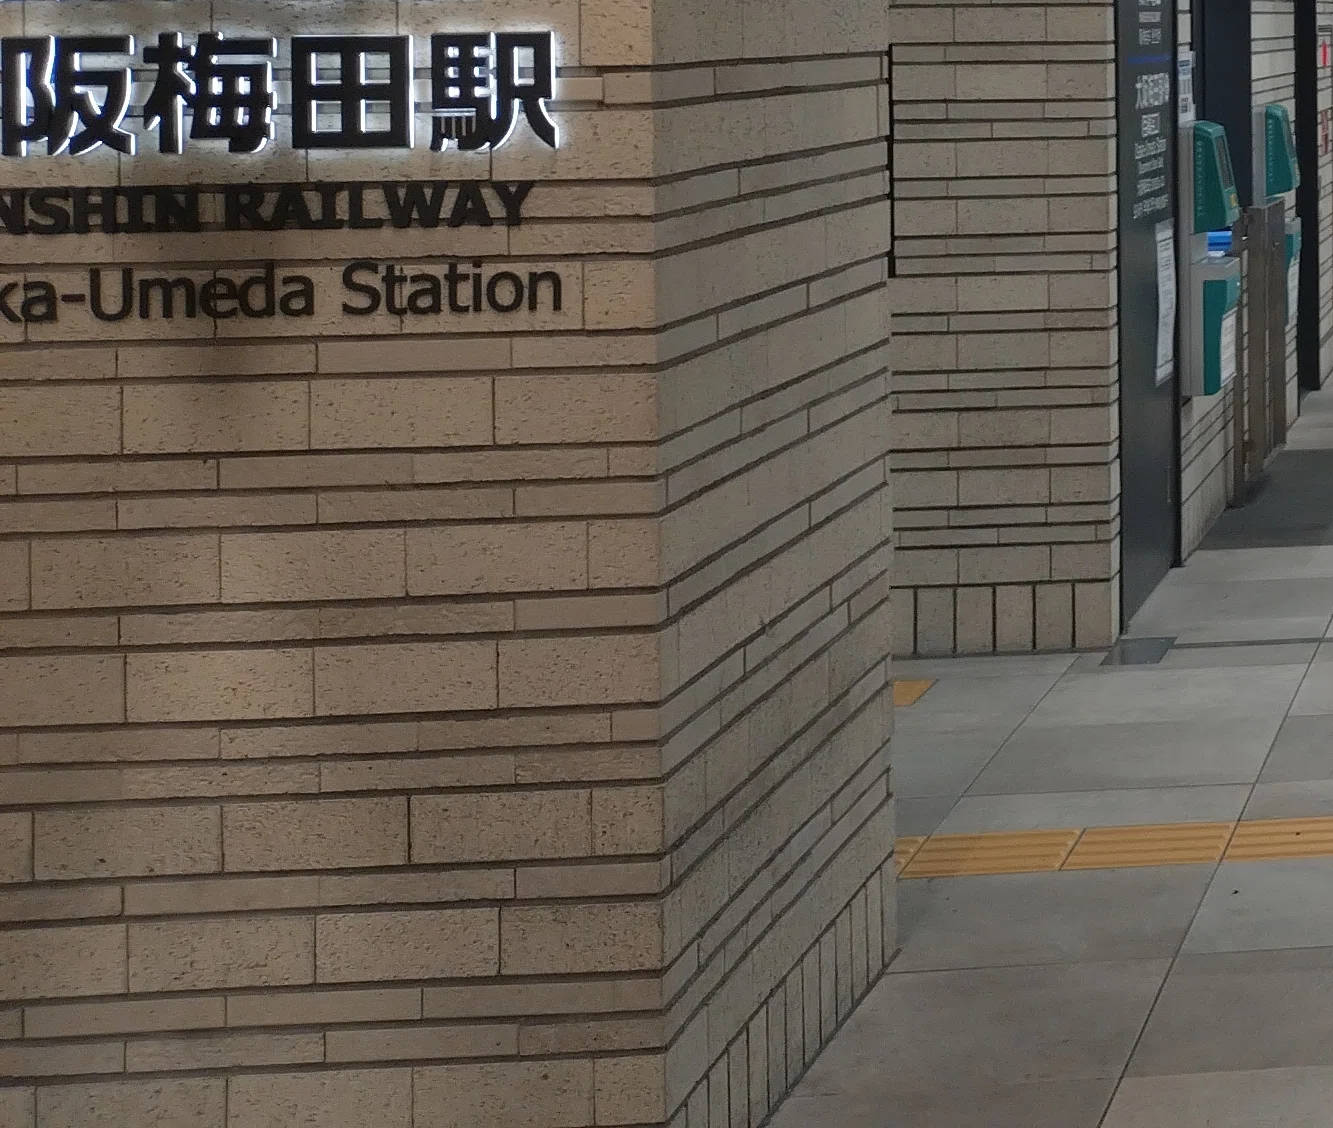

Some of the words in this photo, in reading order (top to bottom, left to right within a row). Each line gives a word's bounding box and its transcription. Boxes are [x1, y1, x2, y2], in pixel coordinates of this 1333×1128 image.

[2, 31, 560, 157] 阪梅田駅
[223, 181, 535, 231] RAILWAY
[341, 260, 562, 316] Station
